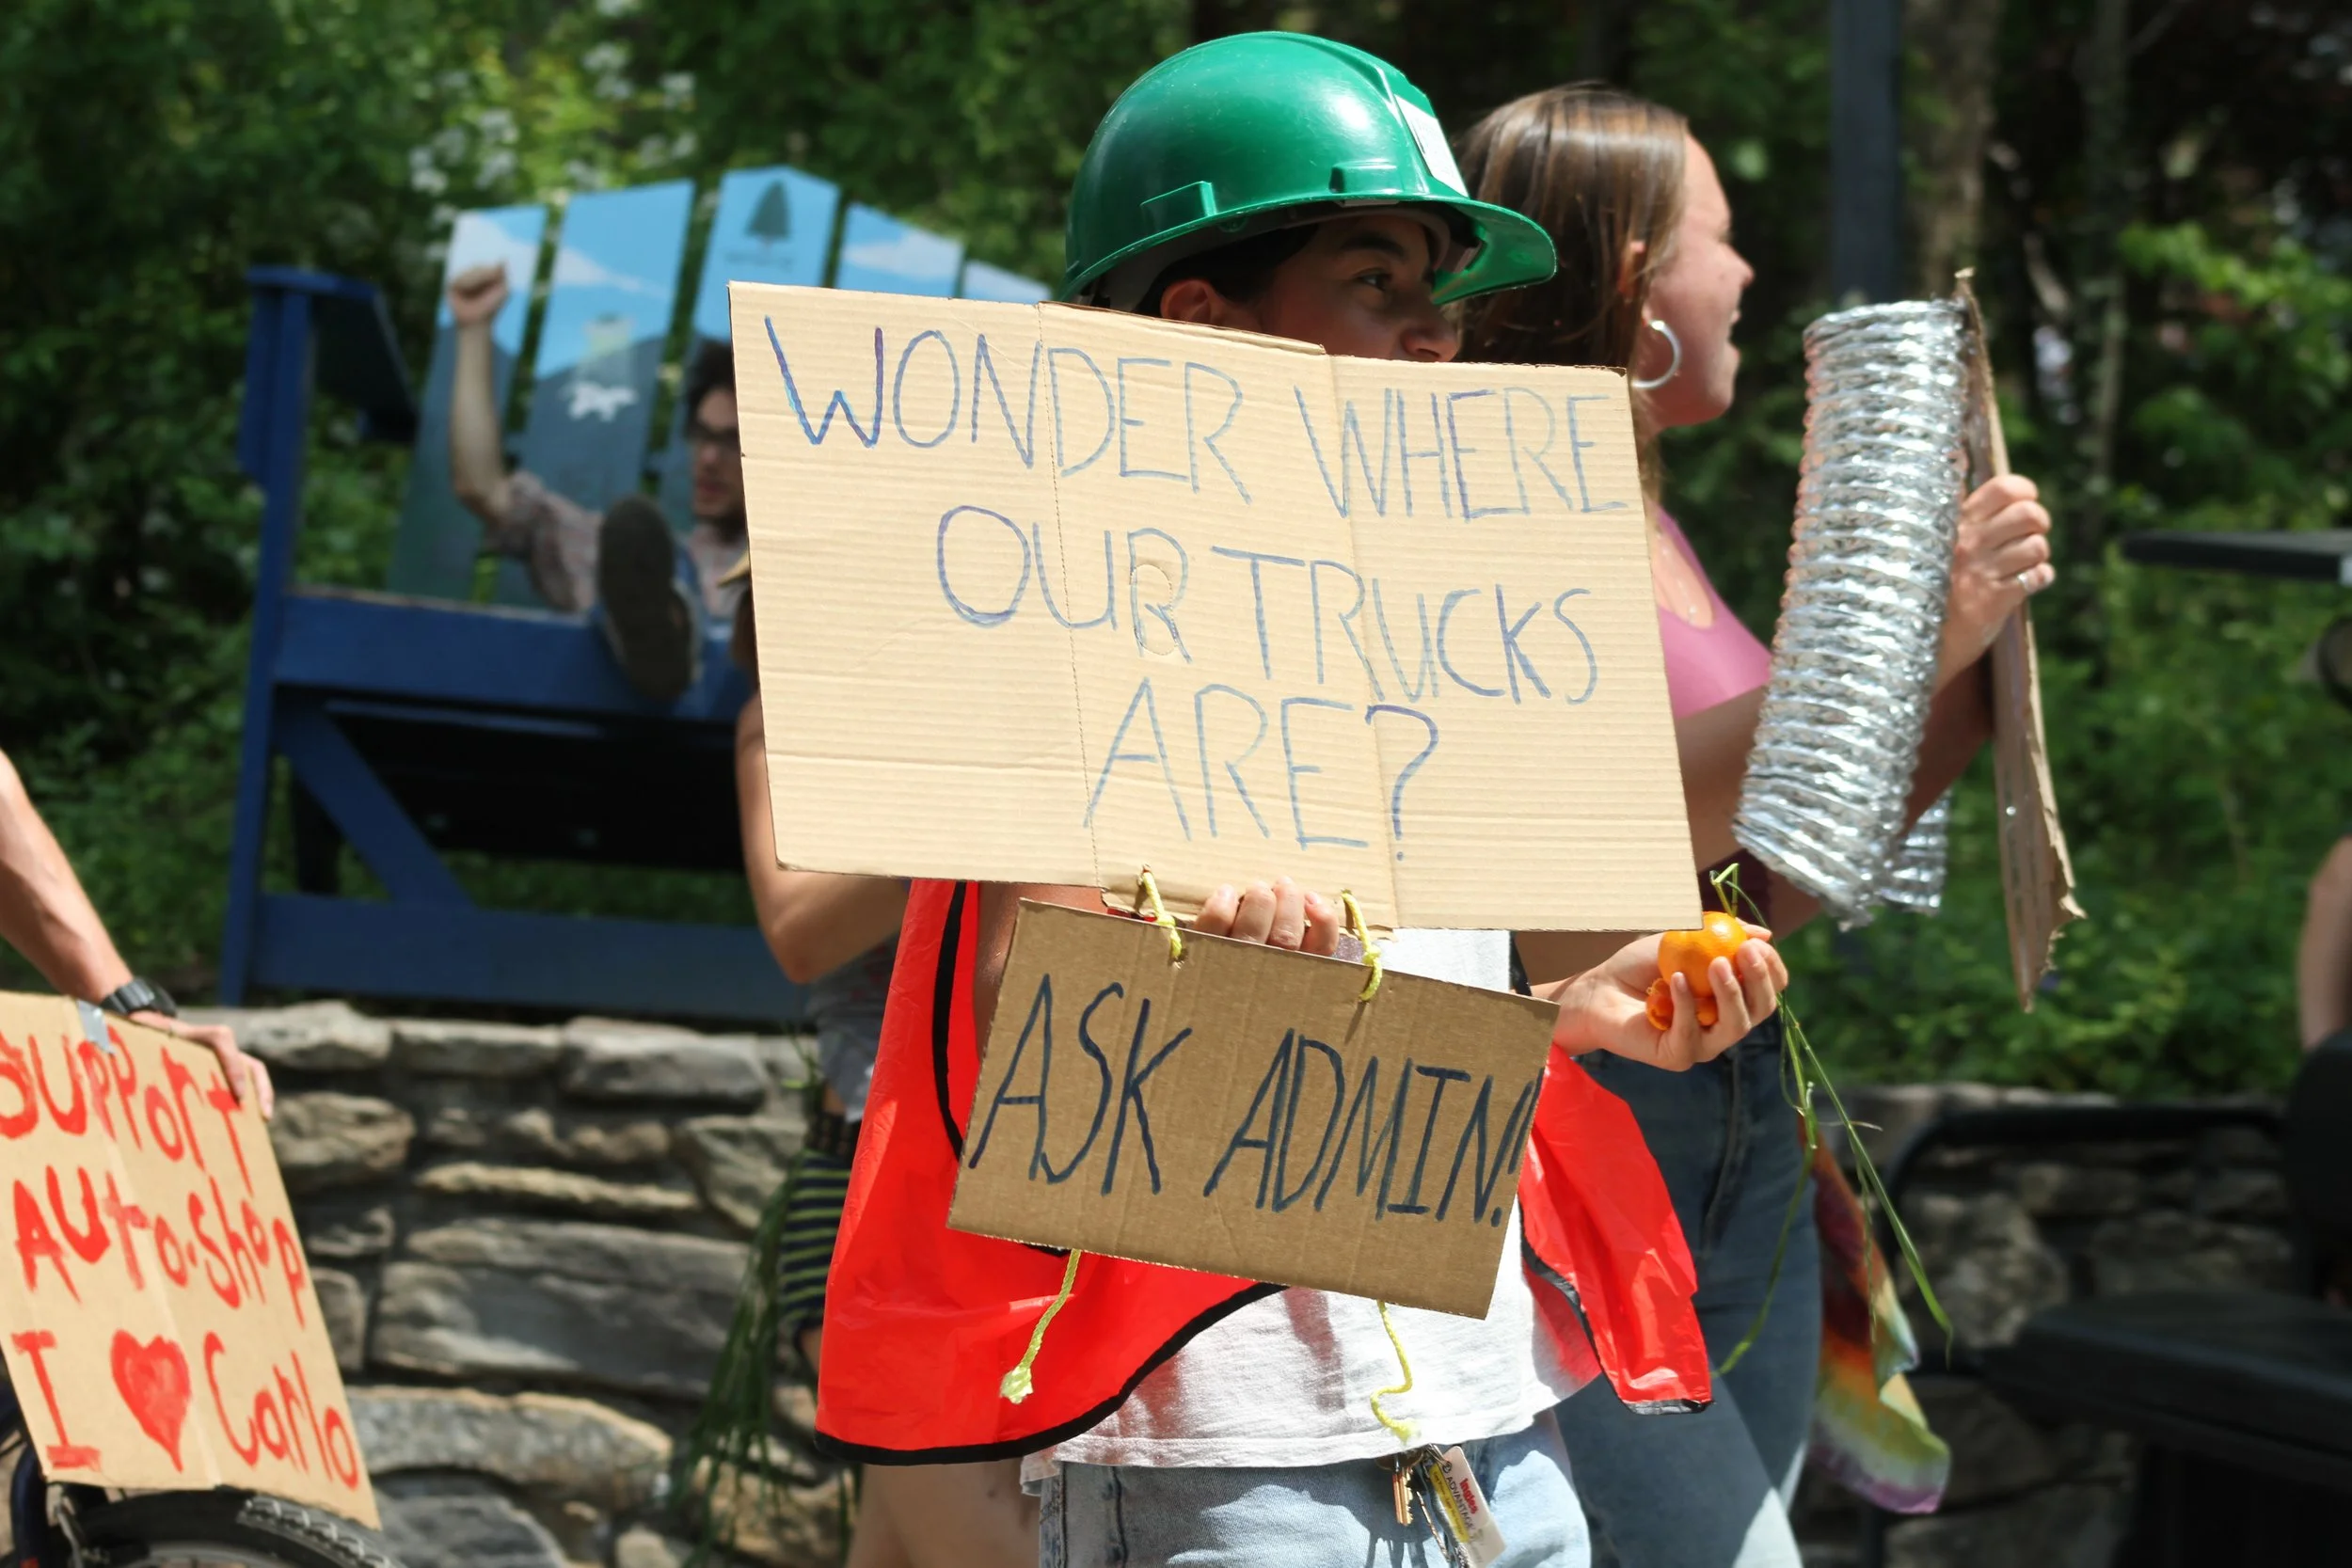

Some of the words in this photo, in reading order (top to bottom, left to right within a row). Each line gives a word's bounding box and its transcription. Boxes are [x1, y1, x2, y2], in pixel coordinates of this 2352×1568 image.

[764, 315, 1253, 505] WONDER
[1293, 385, 1629, 522] WHERE
[936, 504, 1191, 664] OUR
[1210, 545, 1598, 706] TRUCKS
[1083, 677, 1438, 862] ARE?
[968, 973, 1193, 1198] ASK
[1203, 1027, 1545, 1227] ADMIN!
[11, 1329, 101, 1471] I
[203, 1331, 359, 1491] Carlo
[1460, 1478, 1478, 1513] Ingles
